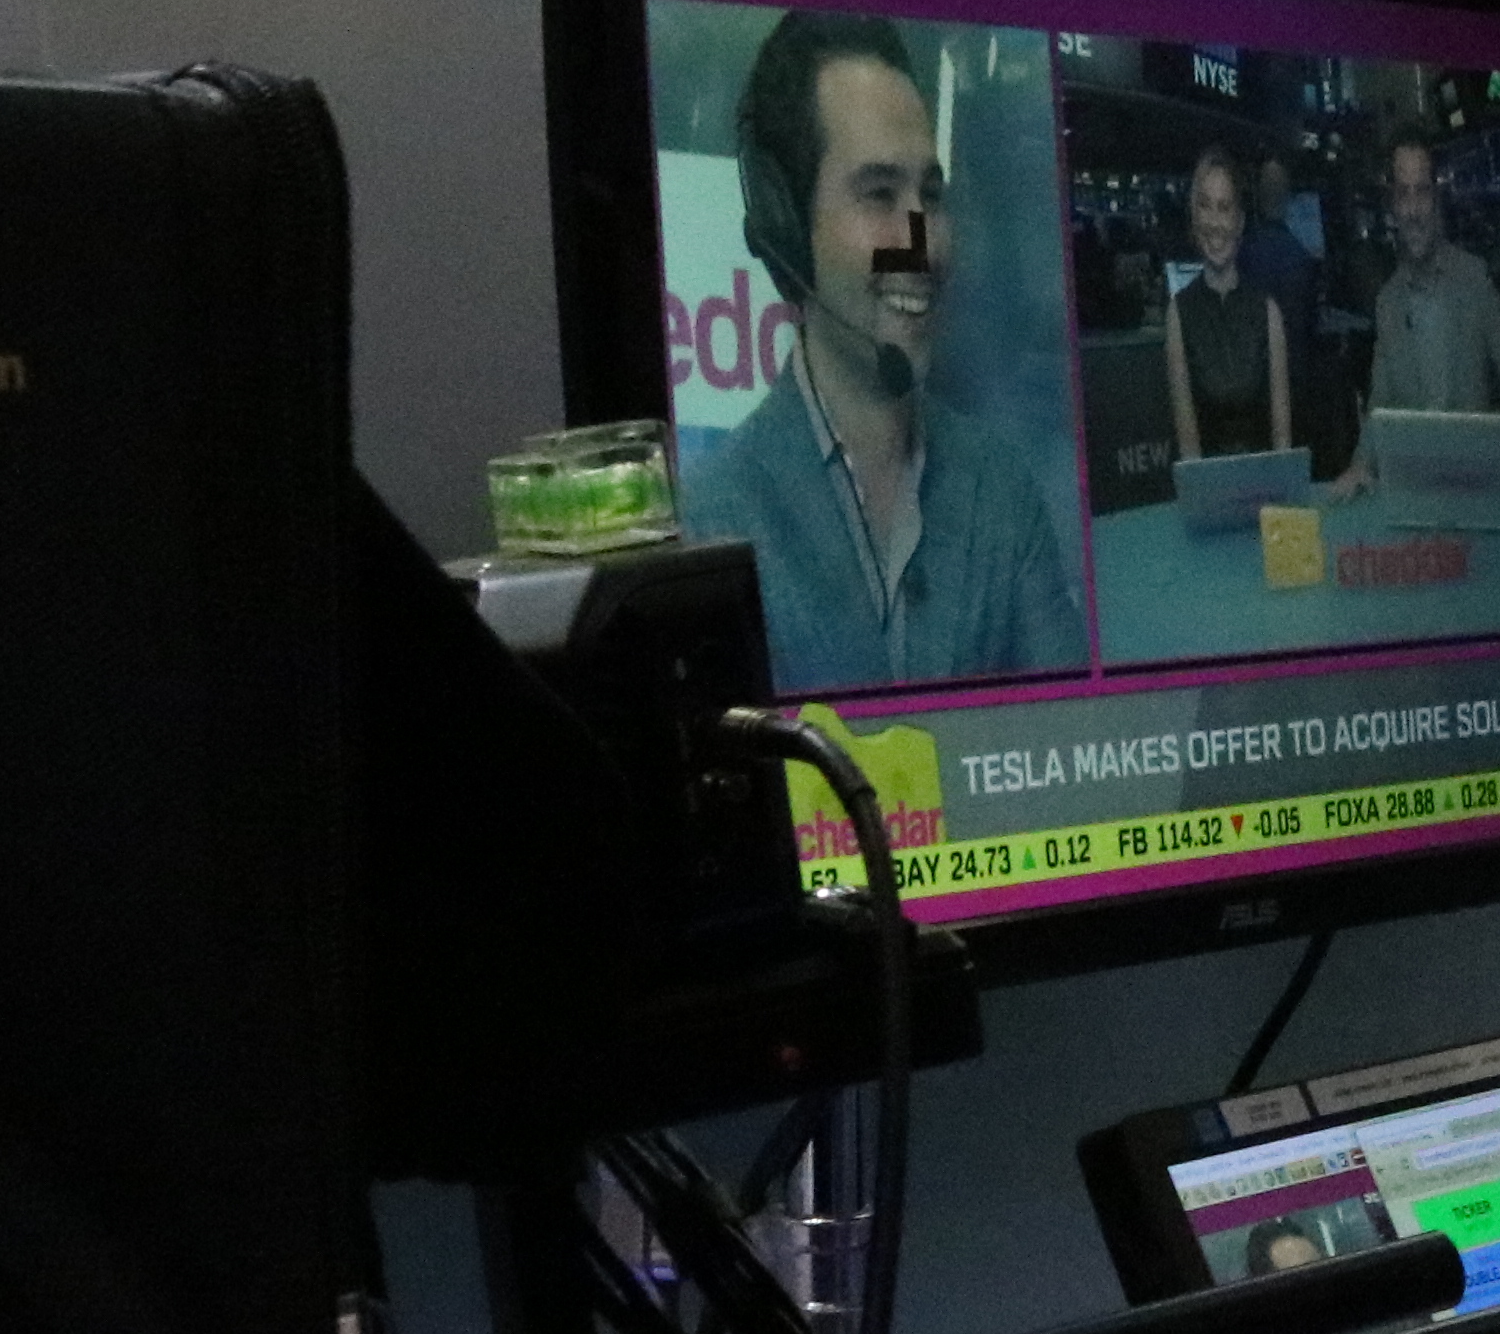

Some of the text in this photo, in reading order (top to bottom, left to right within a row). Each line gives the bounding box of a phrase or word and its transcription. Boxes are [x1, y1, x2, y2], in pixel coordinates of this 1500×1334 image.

[1192, 53, 1239, 98] NYSE
[962, 746, 1067, 795] TESLA
[1073, 732, 1180, 782] MAKES
[1187, 724, 1283, 770] OFFER
[1288, 717, 1327, 757] TO
[1333, 704, 1451, 754] ACQUIRE
[797, 801, 945, 862] chedar
[895, 853, 941, 888] BAY
[950, 845, 1012, 882] 24.73
[1045, 834, 1092, 869] 0.12
[1118, 827, 1149, 859] FB
[1157, 816, 1224, 854] 114.32
[1253, 806, 1301, 838] -0.05
[1324, 797, 1381, 830] FOXA
[1386, 788, 1436, 822] 28.88
[1461, 779, 1499, 810] 0.28
[1451, 1199, 1493, 1219] TICKER
